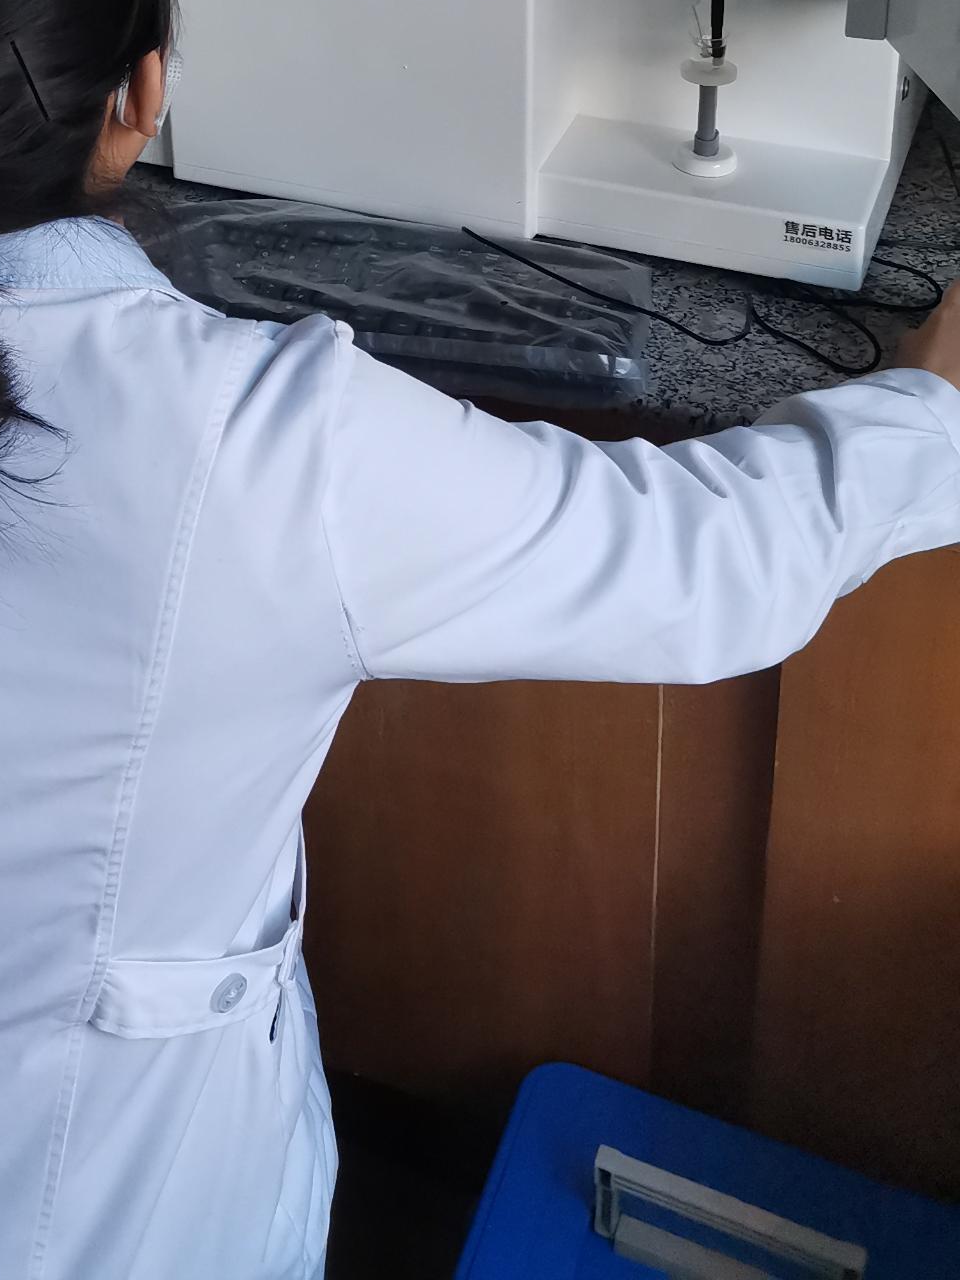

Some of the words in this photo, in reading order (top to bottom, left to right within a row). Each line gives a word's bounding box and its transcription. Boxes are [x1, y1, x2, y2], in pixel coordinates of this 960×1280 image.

[784, 220, 853, 244] 售后电话
[783, 234, 852, 253] 18006328855
